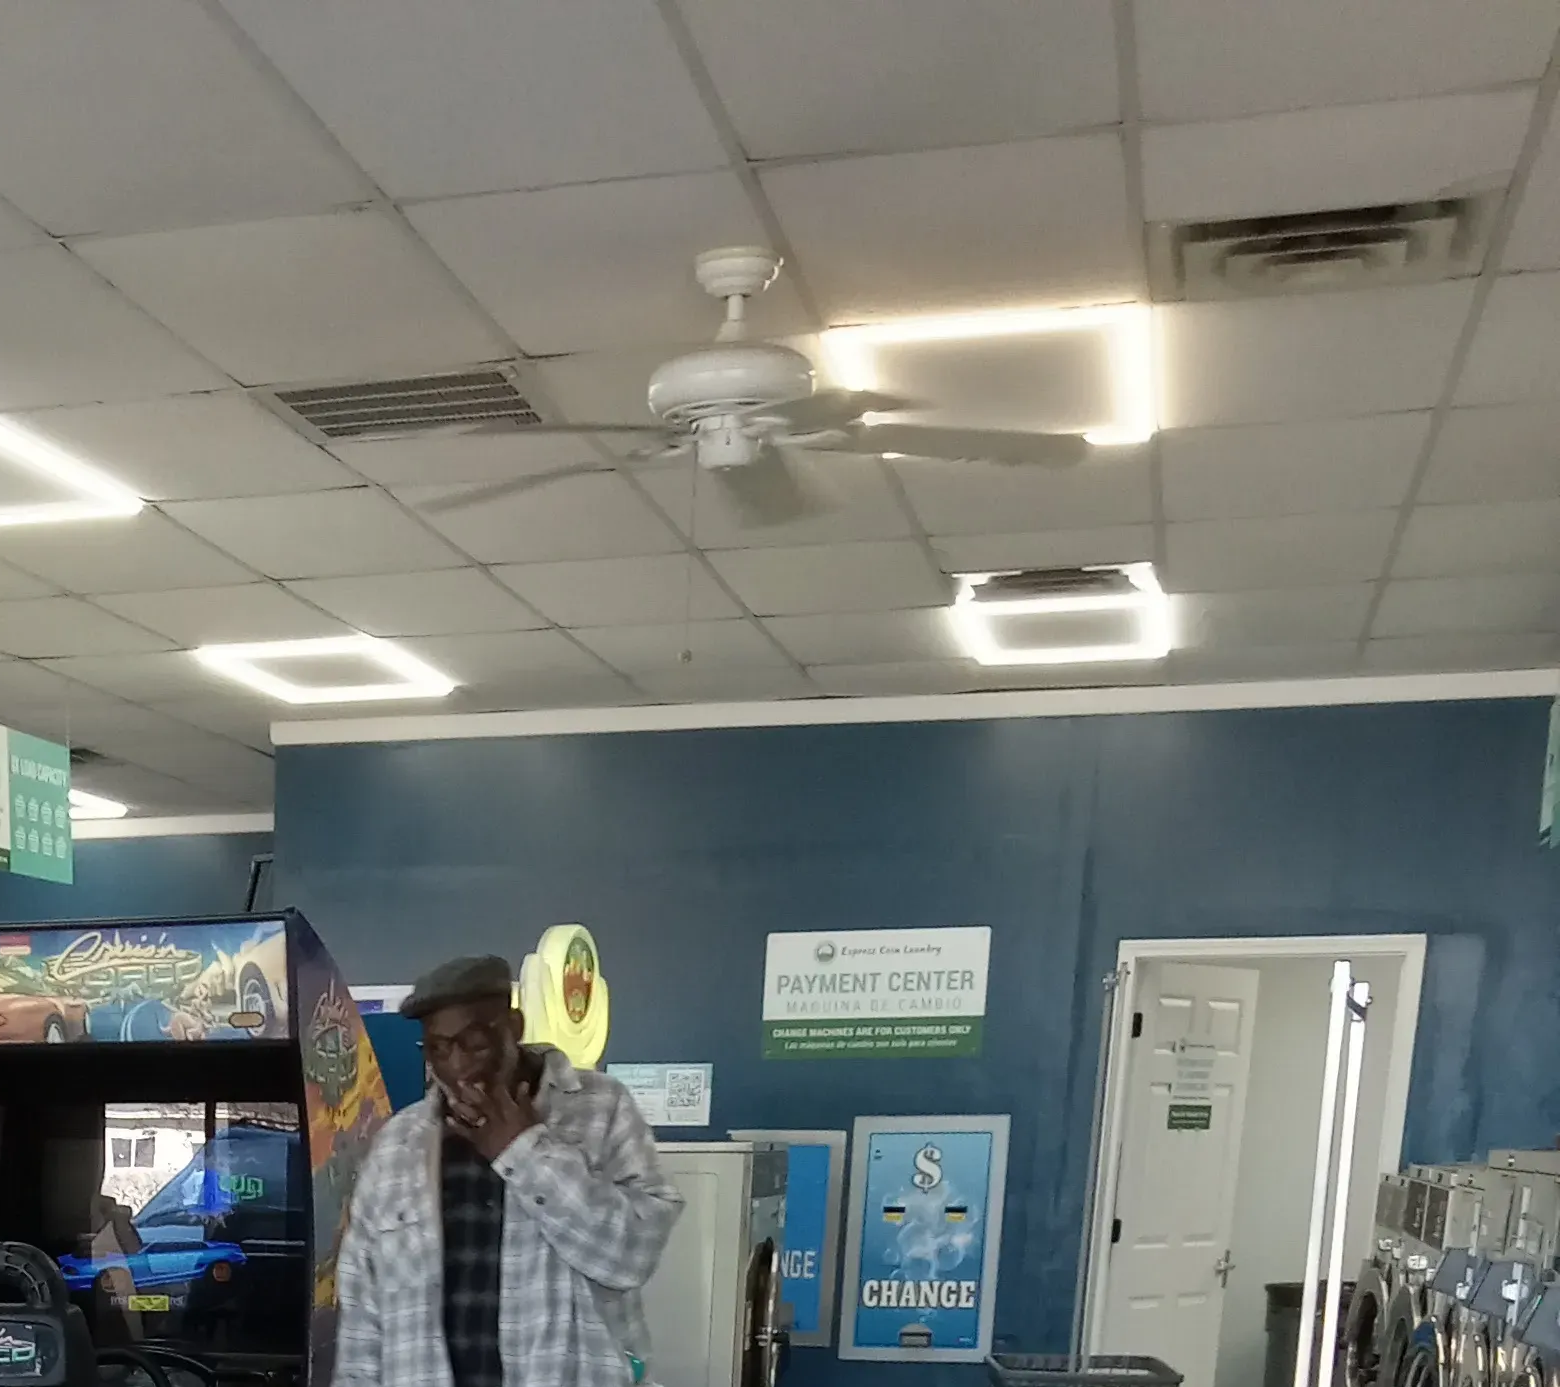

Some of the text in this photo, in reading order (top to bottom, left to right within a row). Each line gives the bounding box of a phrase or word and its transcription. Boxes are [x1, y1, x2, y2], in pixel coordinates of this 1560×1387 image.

[841, 944, 942, 956] Express Coin Laundry
[777, 970, 974, 995] PAYMENT CENTER
[772, 1025, 972, 1038] CHANGE MACHINES ARE FOR CUSTOMERS ONLY
[780, 1249, 817, 1279] NGE
[862, 1279, 976, 1309] CHANGE
